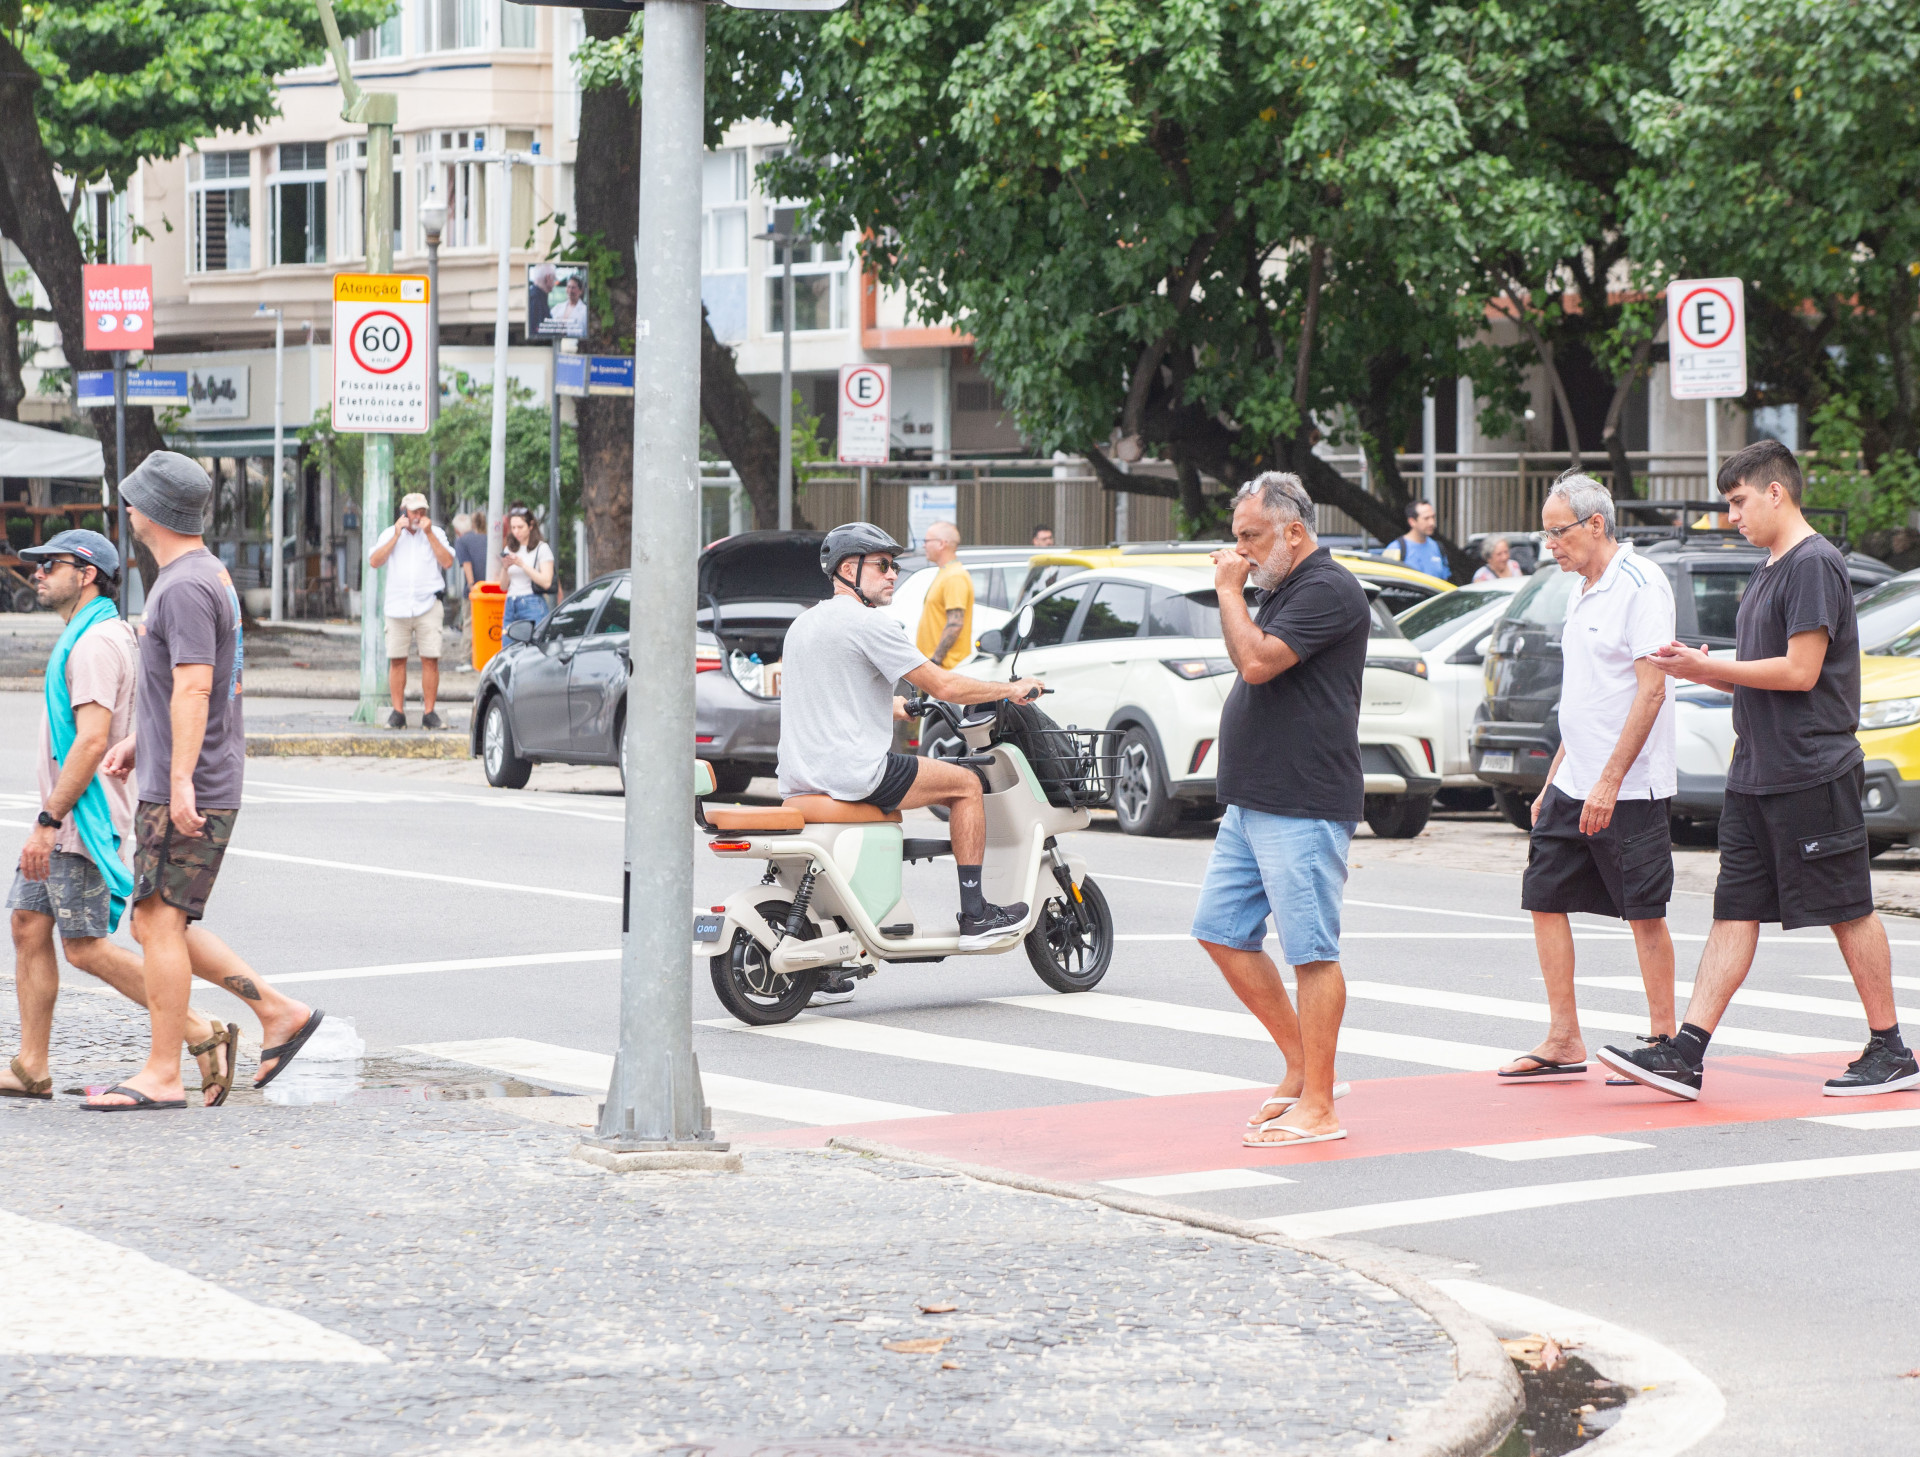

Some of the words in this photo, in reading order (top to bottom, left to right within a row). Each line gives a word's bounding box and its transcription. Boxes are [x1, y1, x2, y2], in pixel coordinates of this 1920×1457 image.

[88, 287, 120, 301] VOCÊ
[121, 286, 150, 301] ESTÁ
[340, 282, 398, 297] Atenção
[88, 301, 122, 312] VENDO
[123, 301, 150, 312] ISSO?
[1697, 302, 1715, 334] E
[362, 326, 400, 352] 60
[341, 380, 421, 392] Fiscalização
[859, 377, 871, 398] E
[339, 396, 404, 407] Eletrônica
[409, 398, 423, 407] de
[347, 412, 415, 422] Velocidade
